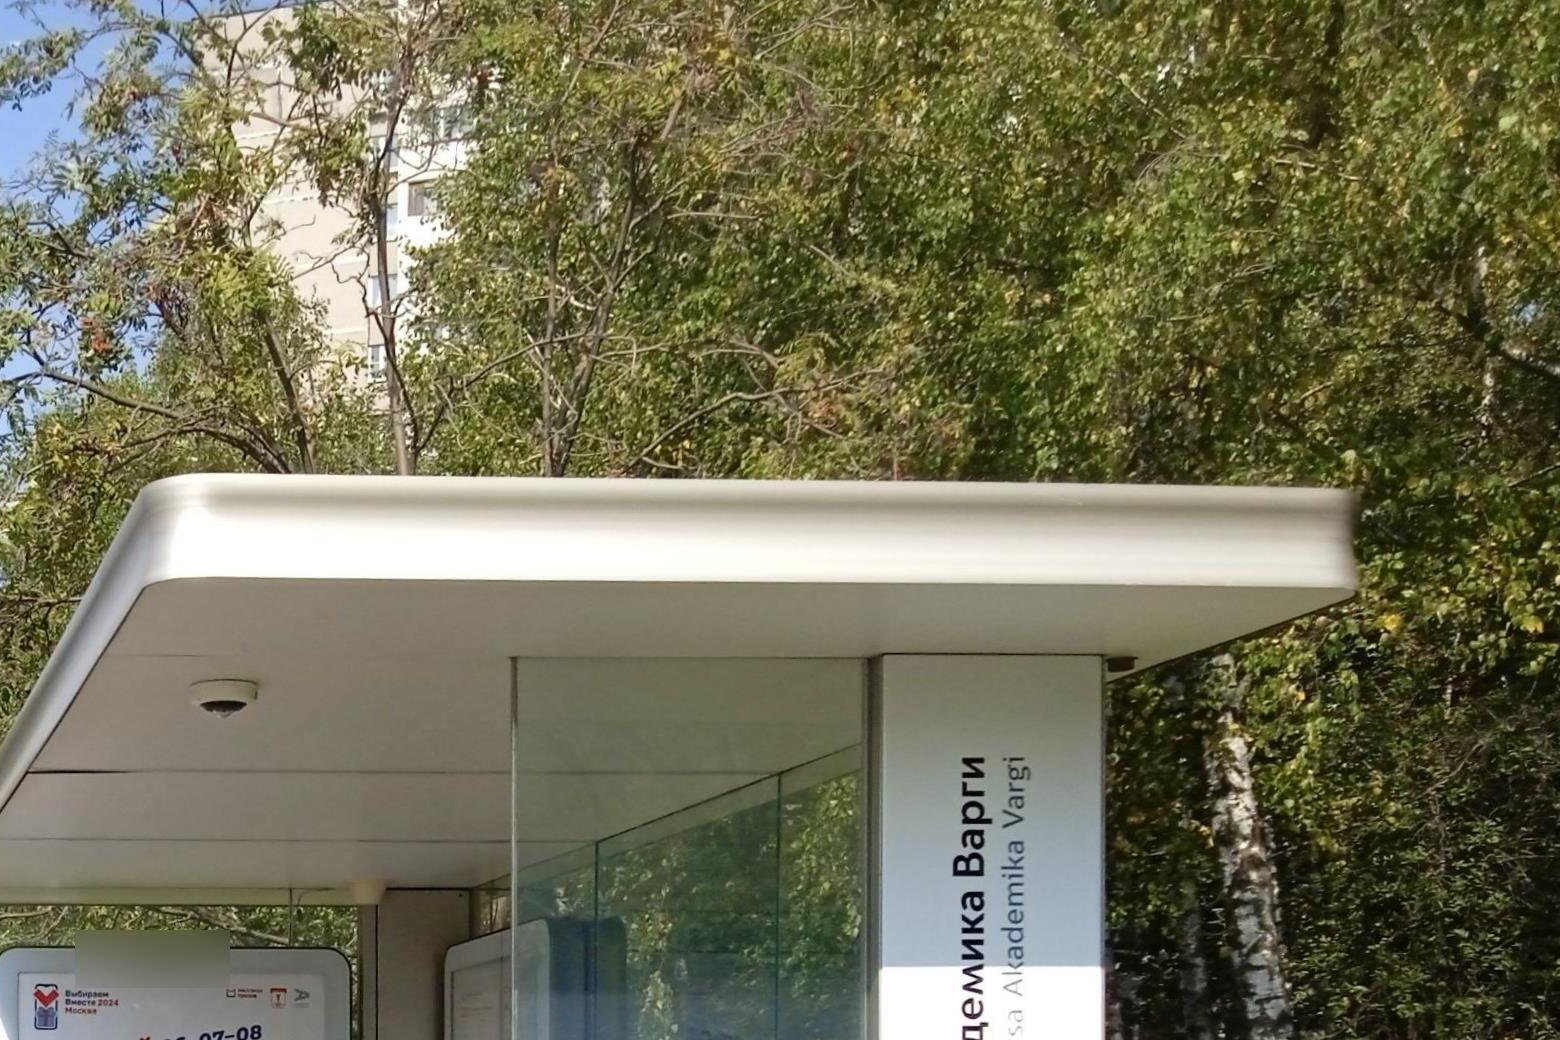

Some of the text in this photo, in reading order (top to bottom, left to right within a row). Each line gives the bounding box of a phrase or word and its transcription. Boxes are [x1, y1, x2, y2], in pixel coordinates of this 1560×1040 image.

[952, 757, 993, 877] Варги
[1002, 757, 1031, 829] Vargi
[1000, 840, 1024, 996] Akademika
[65, 990, 109, 998] Выбираем
[65, 1007, 97, 1015] Москва
